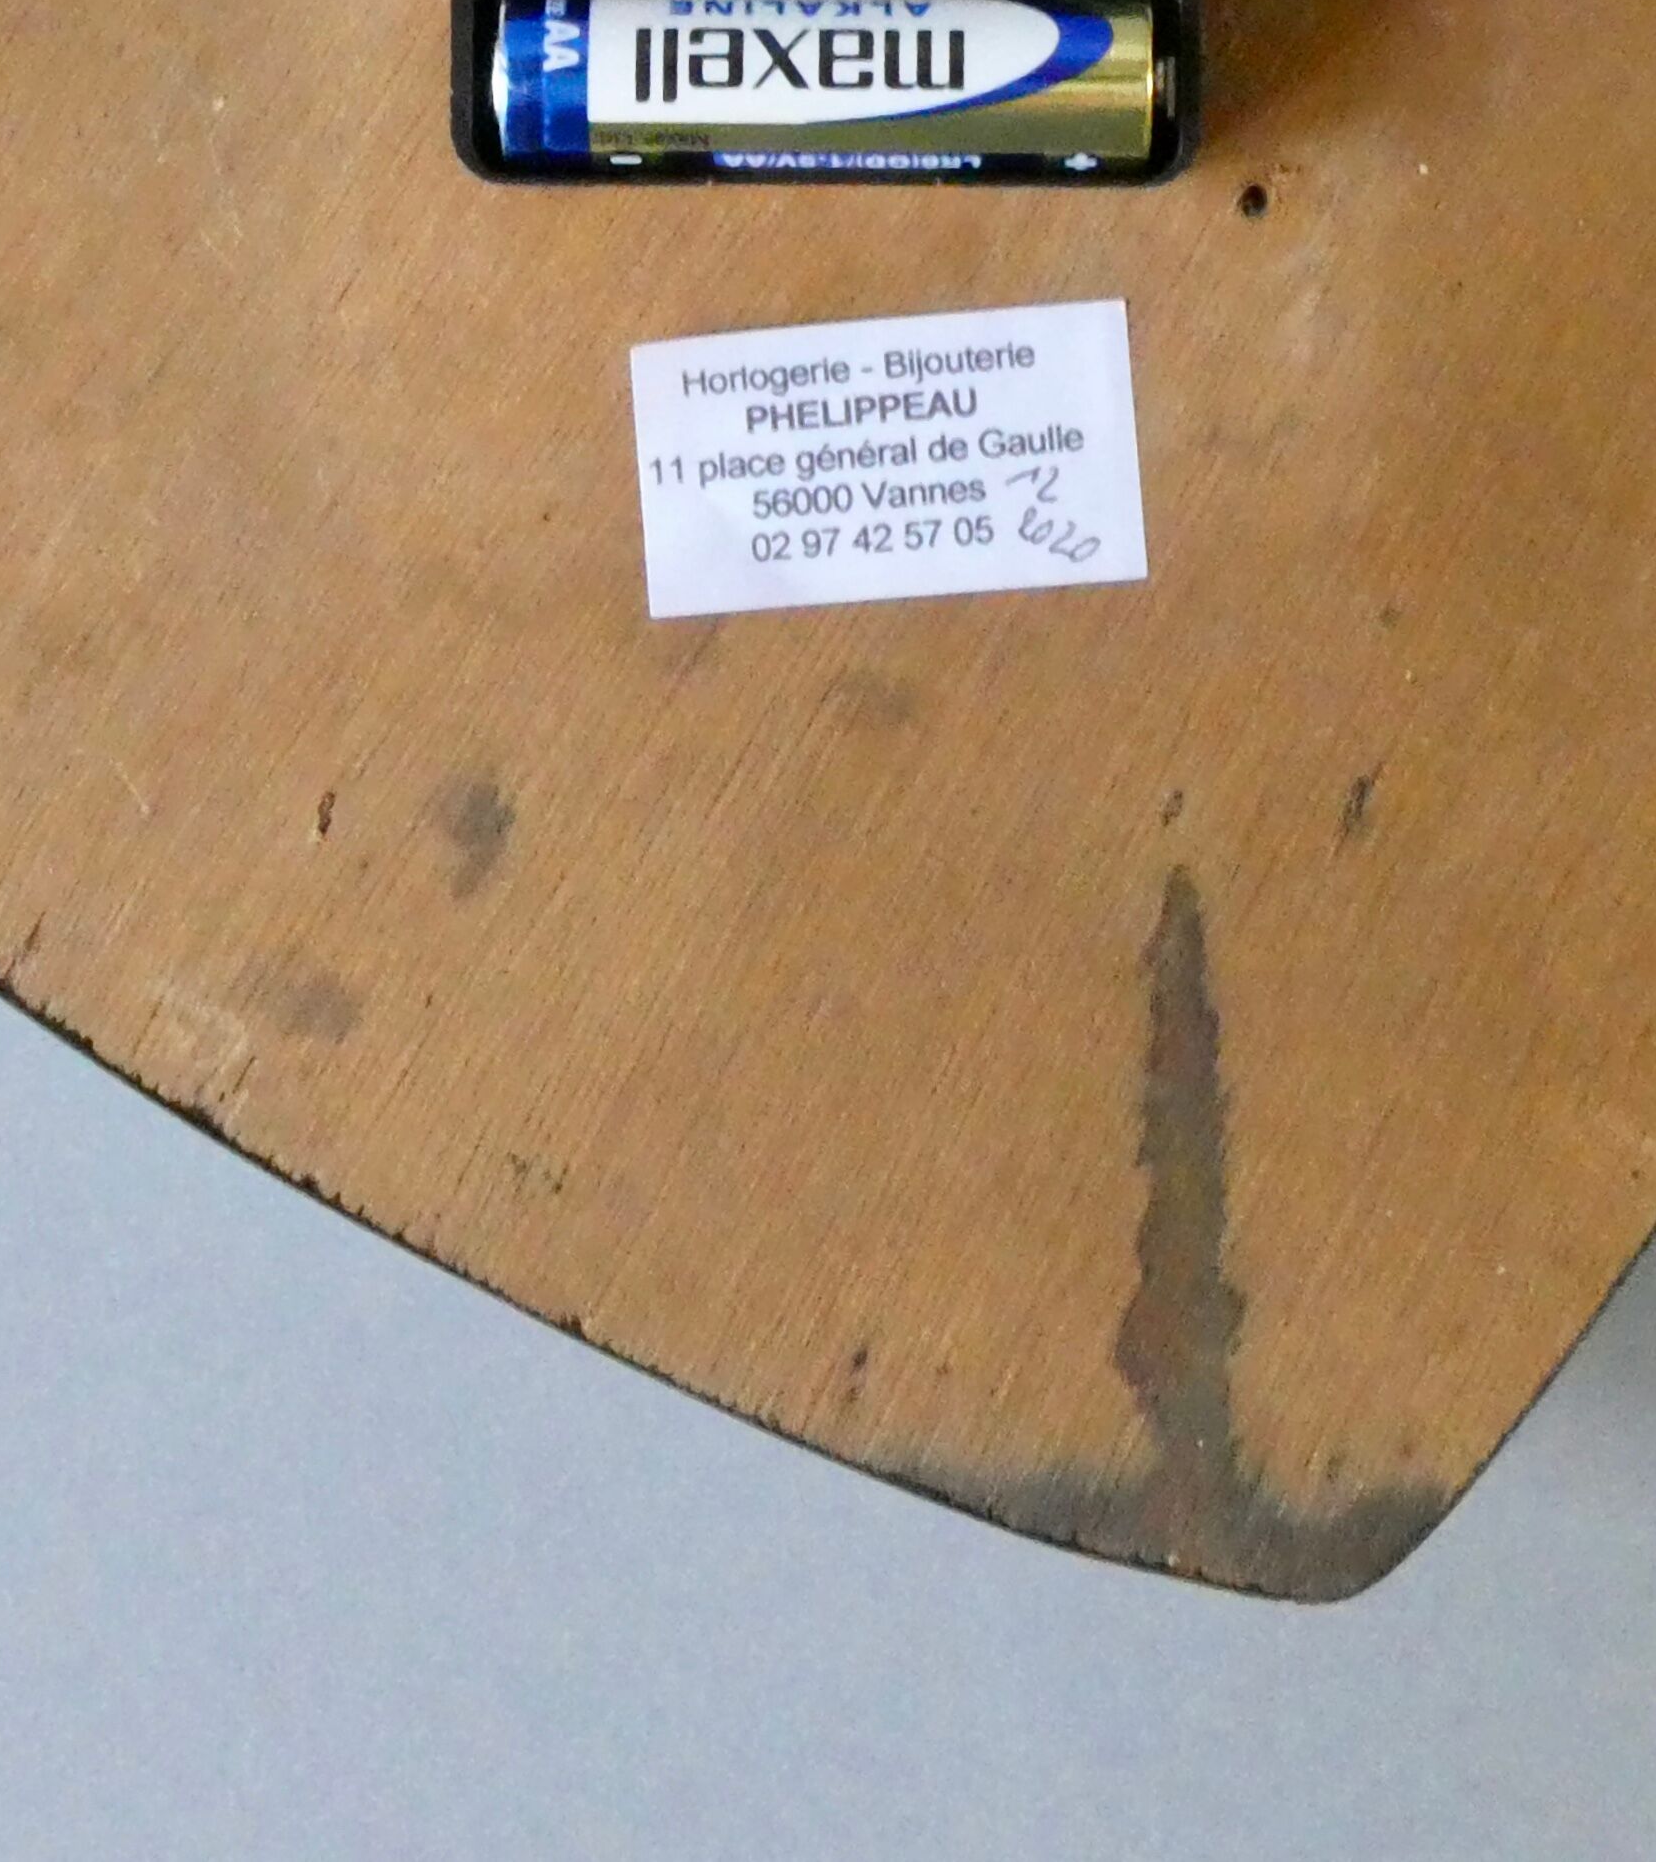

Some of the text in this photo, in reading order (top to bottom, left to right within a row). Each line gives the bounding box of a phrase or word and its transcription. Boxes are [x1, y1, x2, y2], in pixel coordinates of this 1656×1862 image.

[543, 20, 581, 73] AA
[635, 27, 965, 103] maxell
[681, 357, 851, 397] Horlogerie
[883, 341, 1036, 384] Bijouterie
[745, 387, 978, 434] PHELIPPEAU
[650, 423, 1085, 489] 11 place général de Gaulle
[752, 477, 987, 520] 56000 Vannes
[751, 514, 995, 563] 02 97 42 57 05
